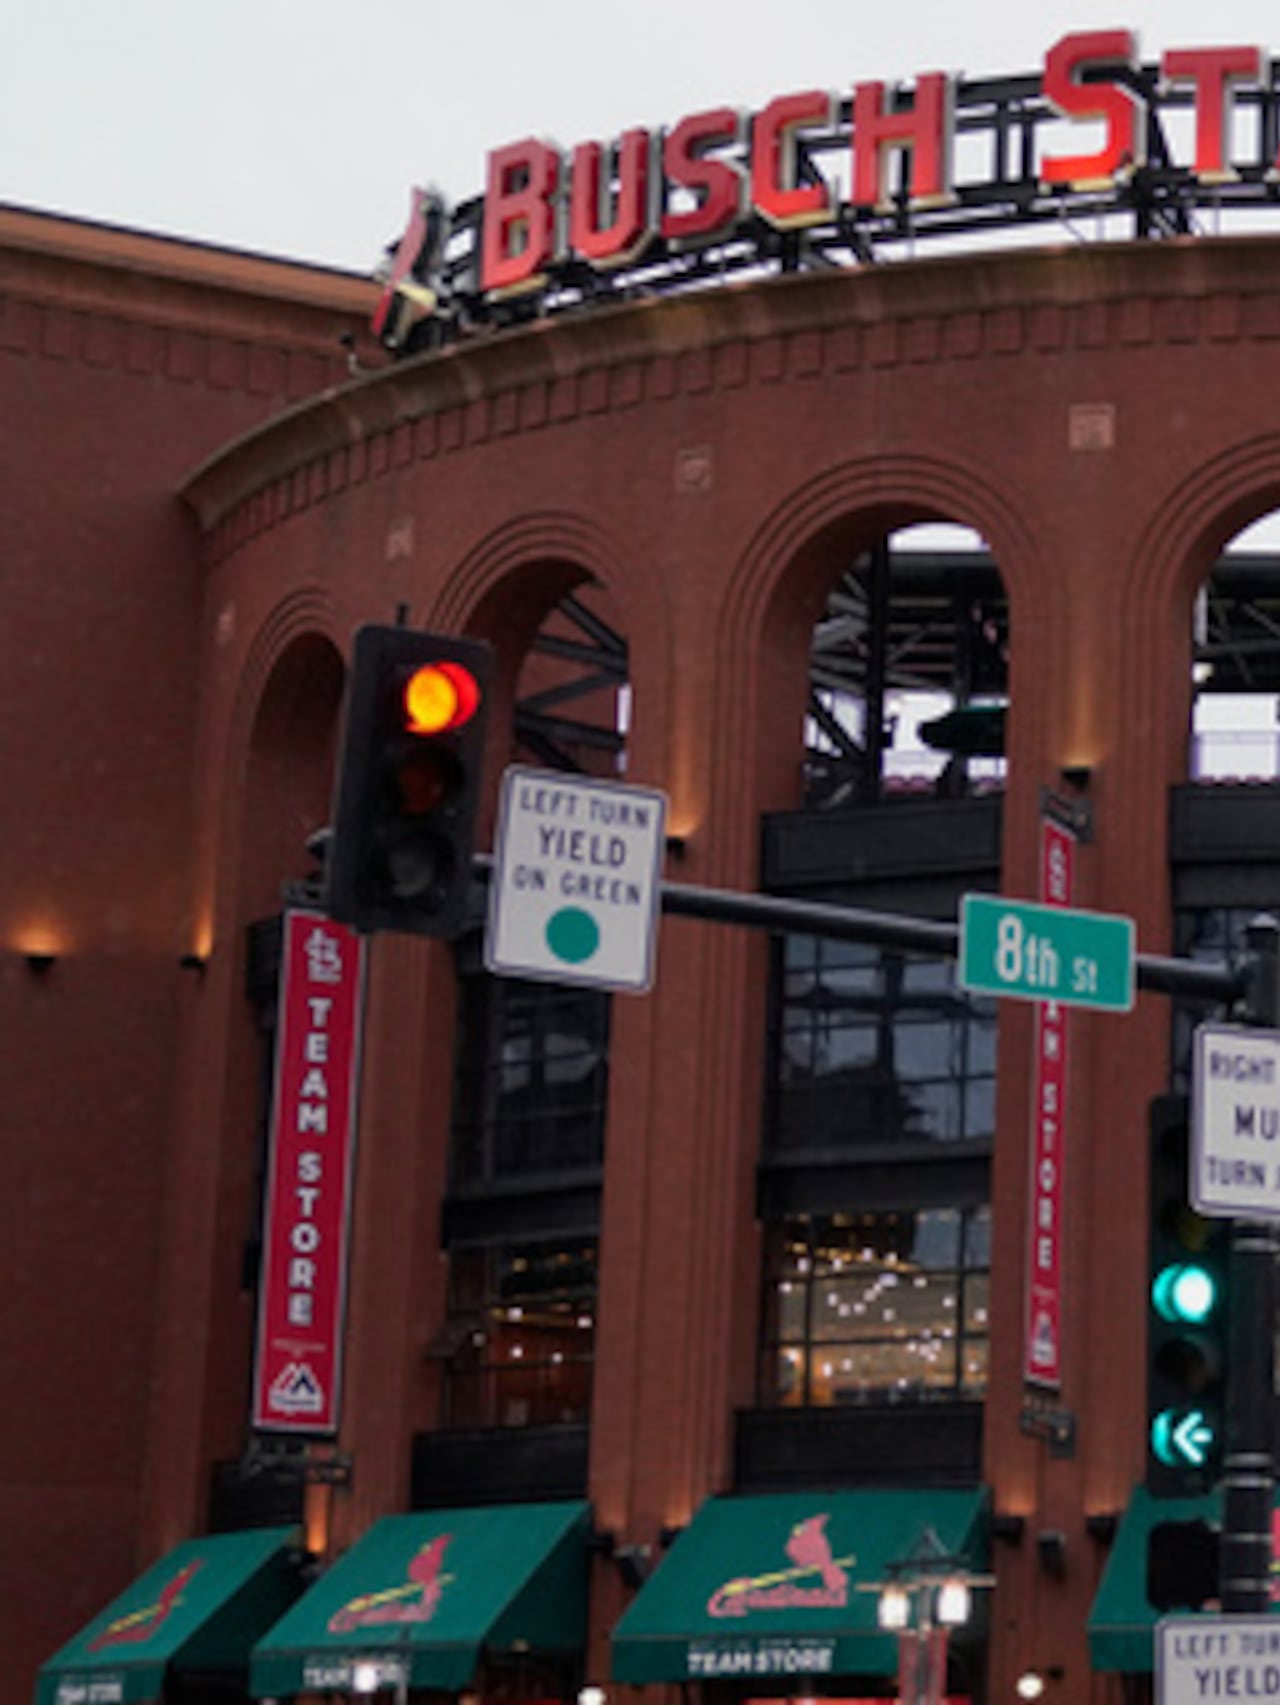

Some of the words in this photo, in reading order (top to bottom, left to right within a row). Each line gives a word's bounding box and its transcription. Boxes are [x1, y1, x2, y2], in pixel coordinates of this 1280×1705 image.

[481, 71, 954, 297] BUSCH
[520, 786, 576, 816] LEFT
[590, 798, 650, 828] TURN
[538, 825, 626, 868] YIELD
[514, 865, 545, 891] ON
[560, 870, 641, 904] GREEN
[996, 914, 1058, 987] 8th
[1072, 956, 1098, 994] St
[297, 997, 333, 1135] TEAM
[1210, 1051, 1275, 1085] RIGHT
[1207, 1156, 1265, 1188] TURN
[287, 1151, 323, 1326] STORE
[687, 1652, 752, 1675] TEAM
[755, 1648, 832, 1673] STORE
[1175, 1634, 1229, 1658] LEFT
[1196, 1666, 1280, 1697] YIELD
